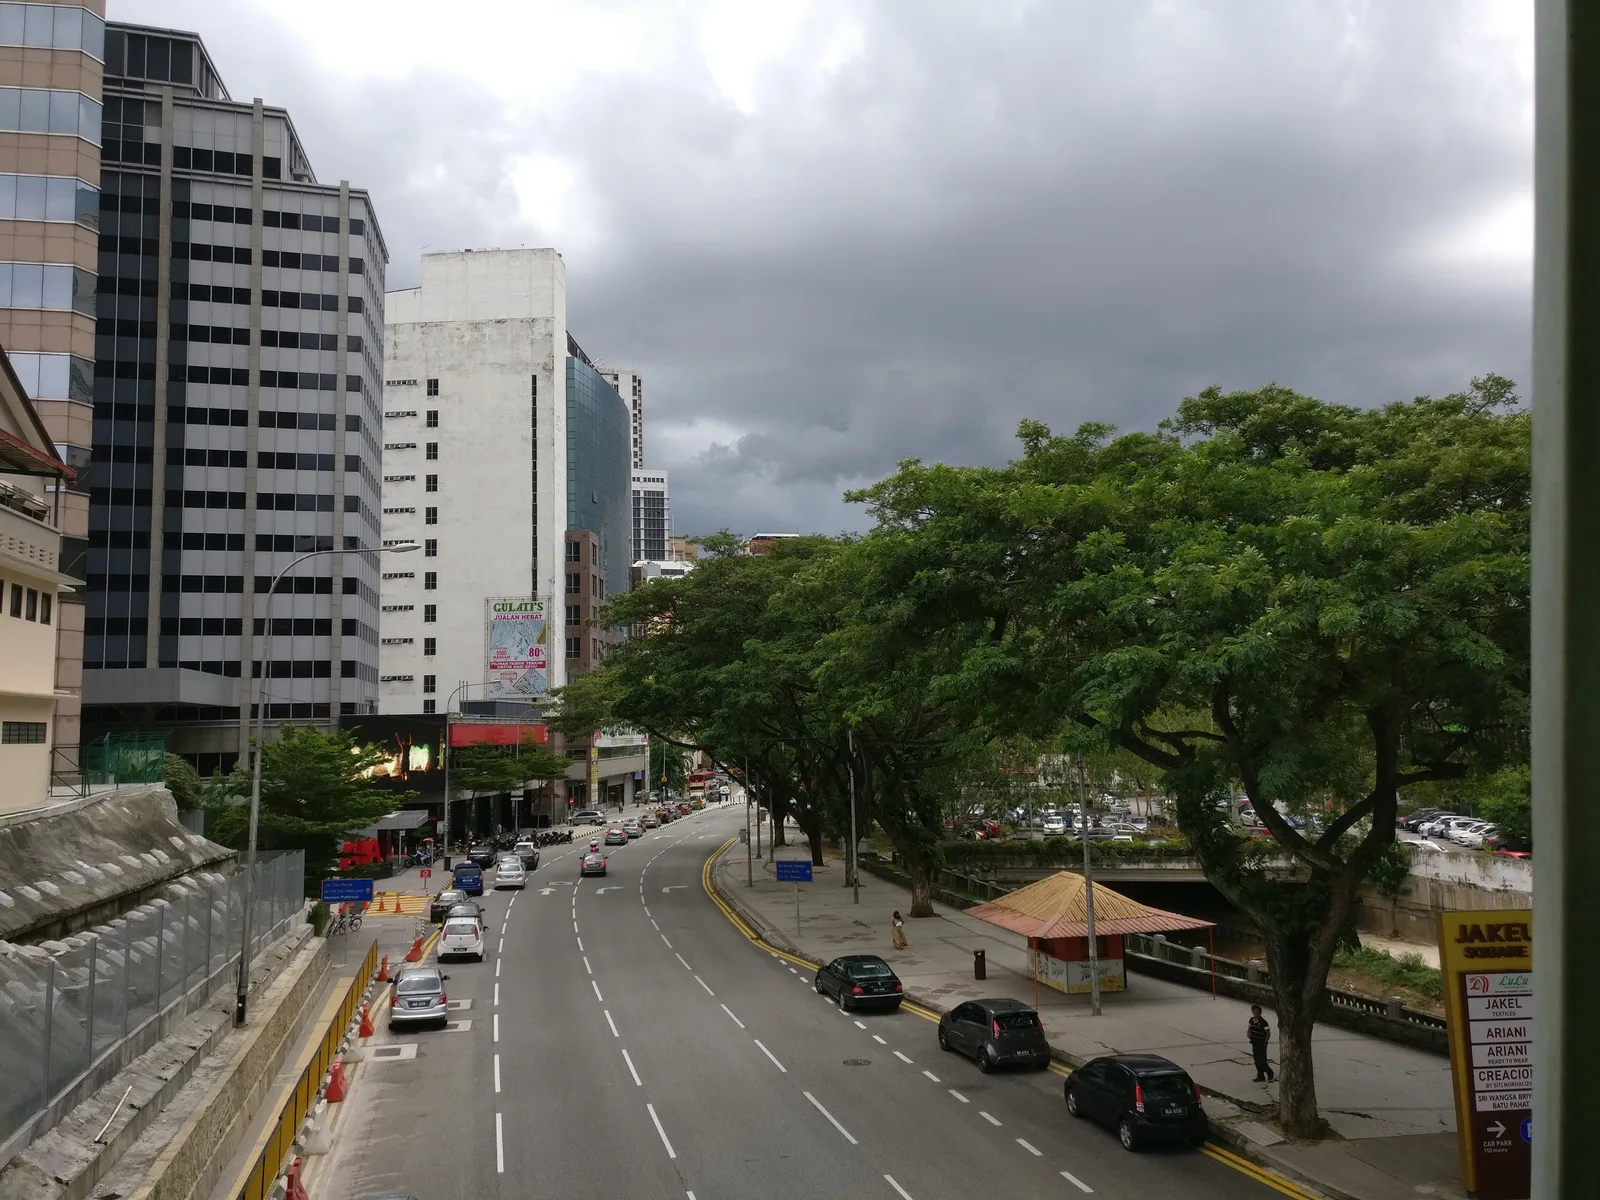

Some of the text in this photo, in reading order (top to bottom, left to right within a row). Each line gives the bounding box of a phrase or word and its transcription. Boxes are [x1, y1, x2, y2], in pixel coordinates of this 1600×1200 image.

[493, 602, 544, 612] GULATI'S
[1455, 923, 1532, 943] JAKEL
[1485, 998, 1522, 1010] JAKEL
[1486, 1026, 1527, 1039] ARIANI
[1487, 1045, 1528, 1057] ARIANI
[1489, 1093, 1517, 1101] WANGSA
